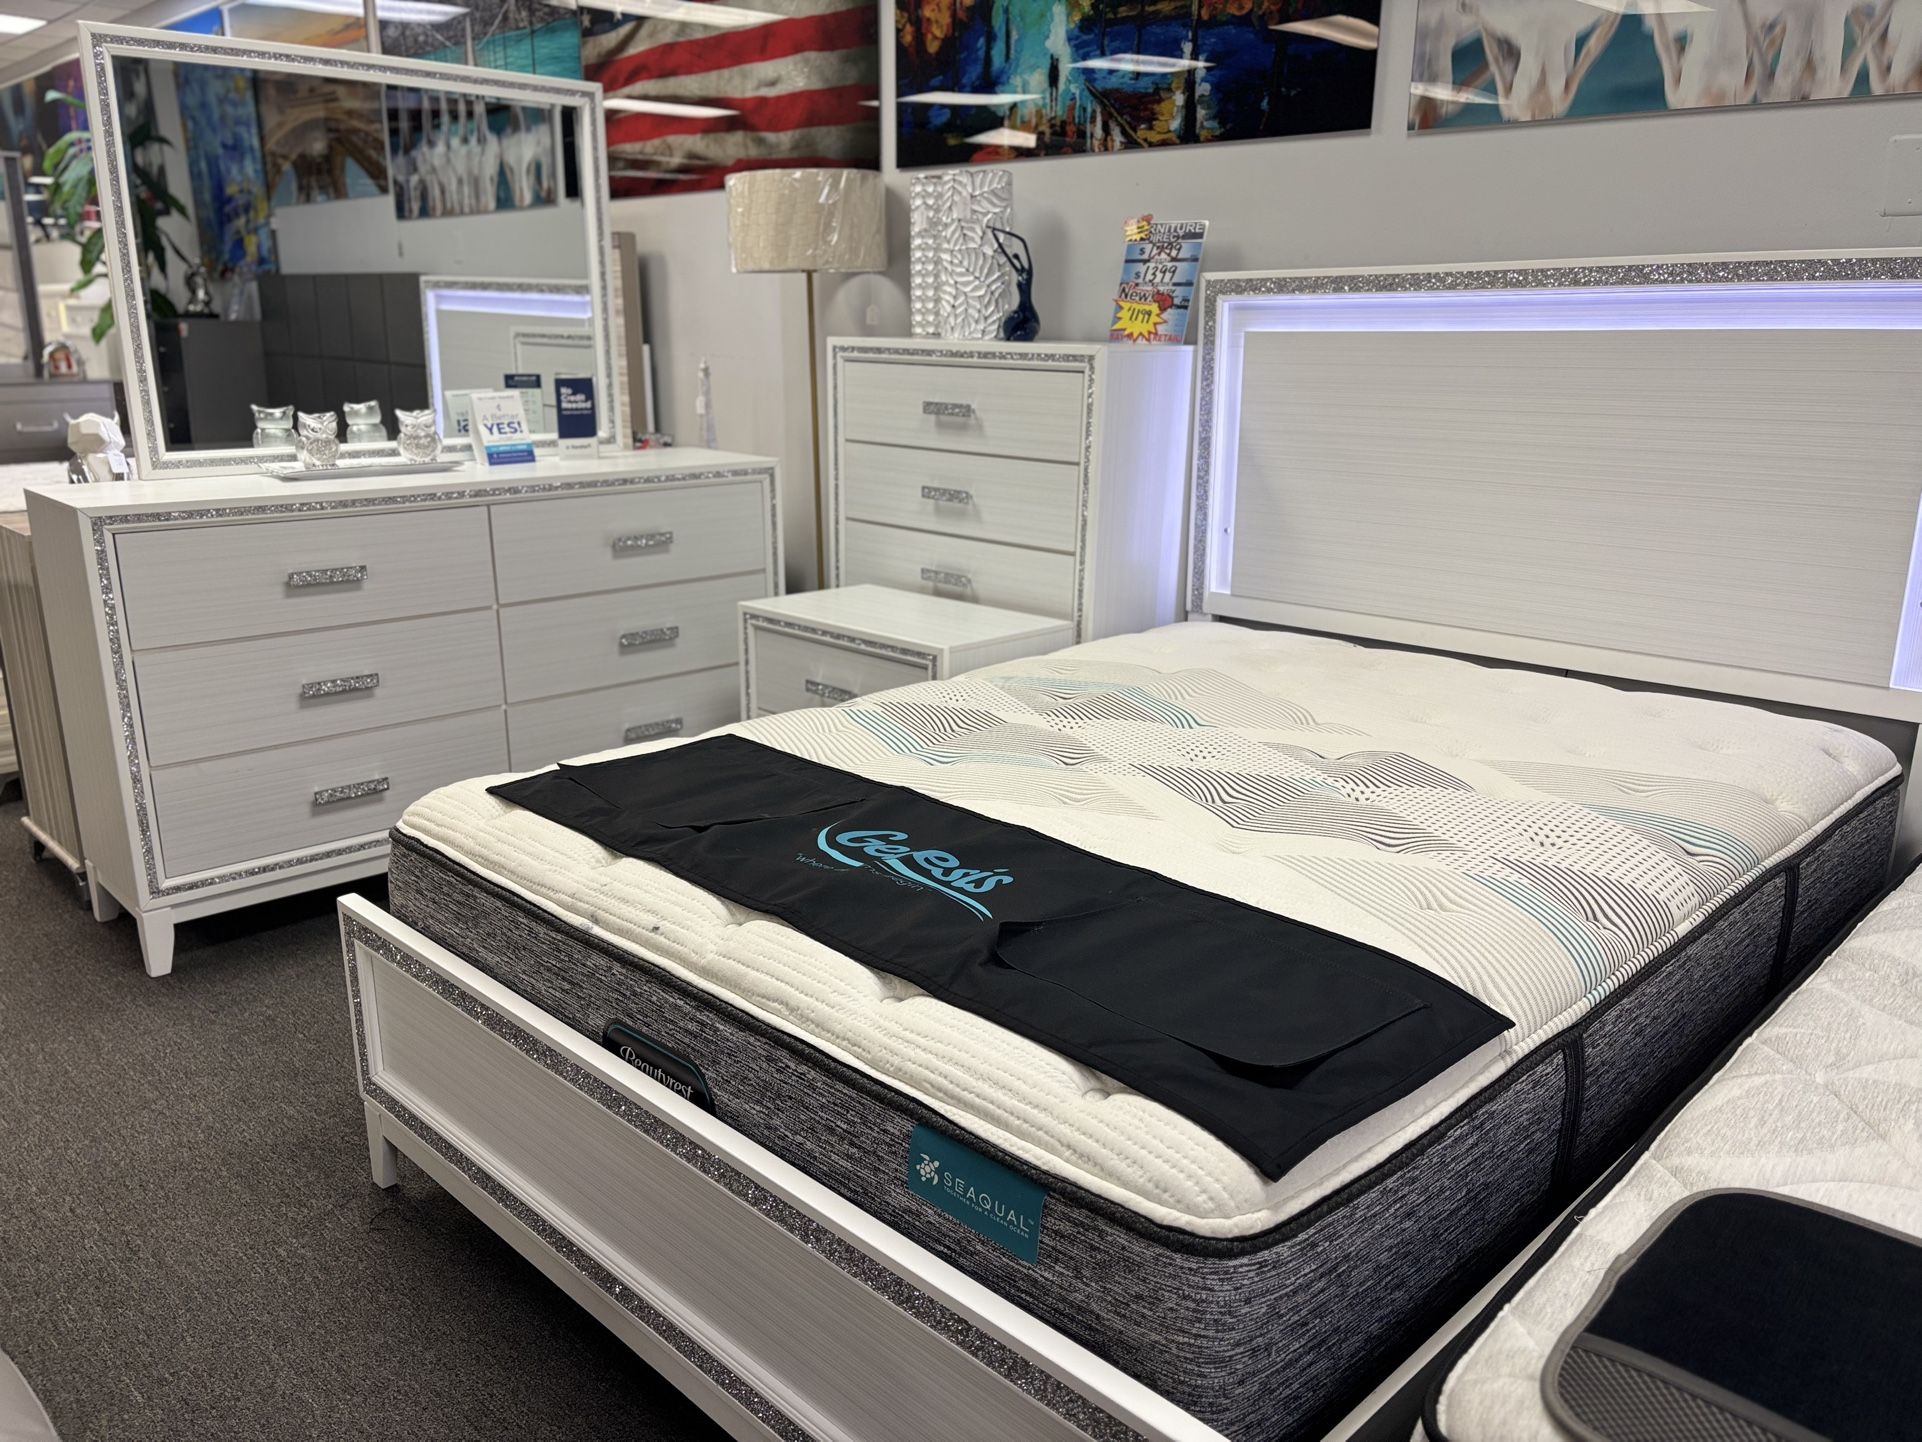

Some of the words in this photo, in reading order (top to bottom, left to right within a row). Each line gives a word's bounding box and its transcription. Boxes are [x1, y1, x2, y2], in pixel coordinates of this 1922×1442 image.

[1143, 264, 1178, 283] 1399
[483, 421, 523, 436] YES!
[943, 1171, 1030, 1232] SEAQUAL
